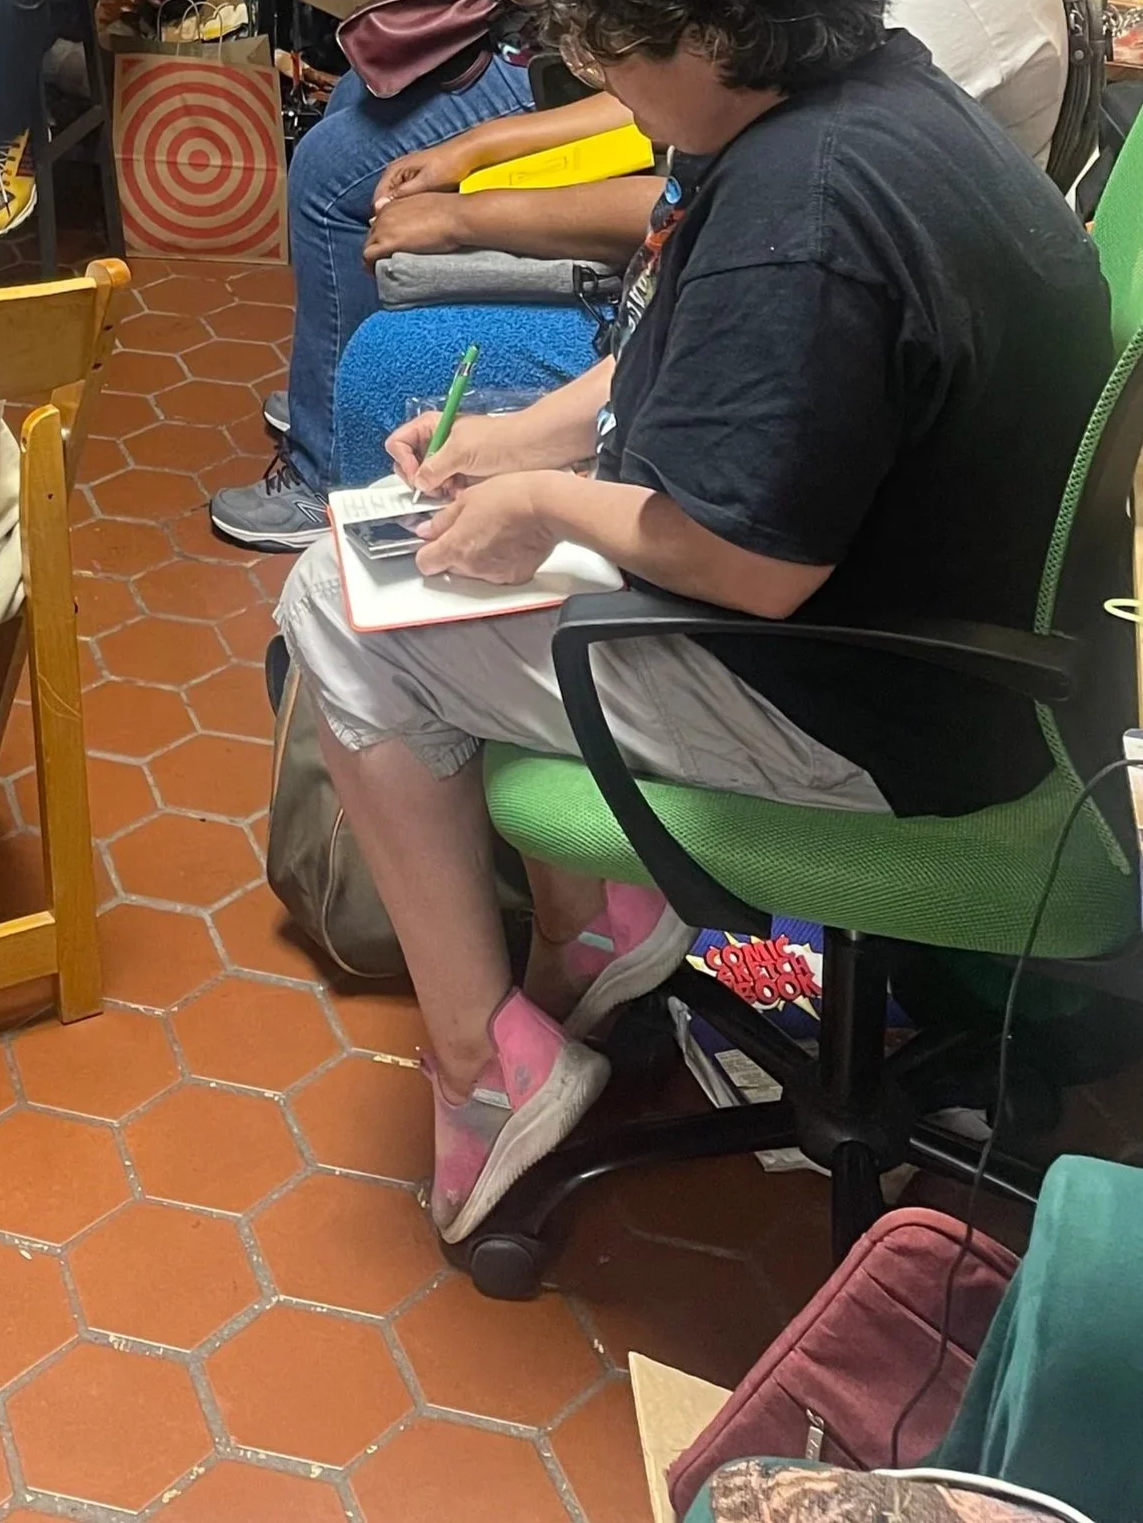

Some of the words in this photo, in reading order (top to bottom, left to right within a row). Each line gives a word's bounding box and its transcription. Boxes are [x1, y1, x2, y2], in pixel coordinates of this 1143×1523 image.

[705, 934, 791, 970] COMIC
[717, 954, 815, 988] SKETCH
[733, 972, 823, 1006] BOOK
